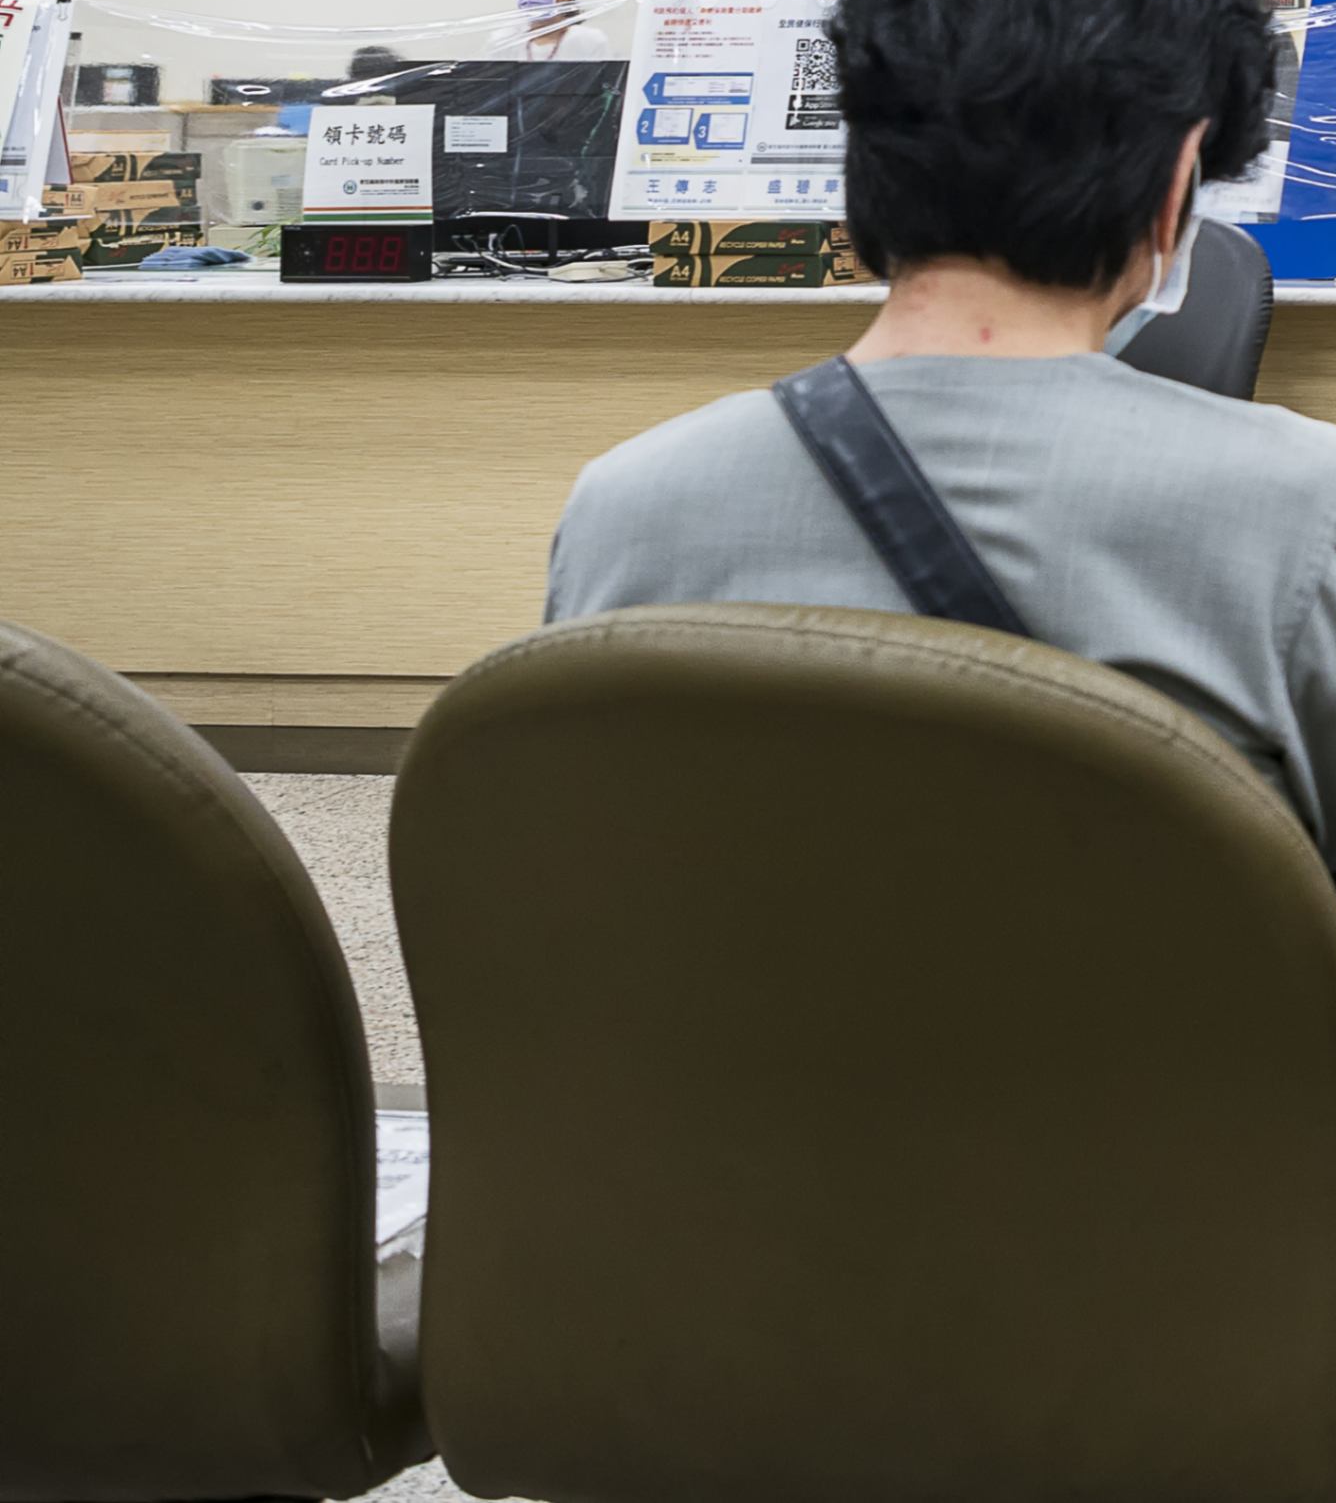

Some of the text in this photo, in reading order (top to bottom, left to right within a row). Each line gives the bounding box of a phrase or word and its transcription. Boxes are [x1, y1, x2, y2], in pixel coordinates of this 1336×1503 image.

[651, 83, 659, 95] 1
[323, 123, 407, 145] 領卡號碼
[641, 122, 648, 134] 2
[698, 126, 706, 138] 3
[319, 157, 338, 166] Card
[377, 157, 405, 166] Number
[671, 230, 690, 243] A4
[671, 265, 690, 277] A4
